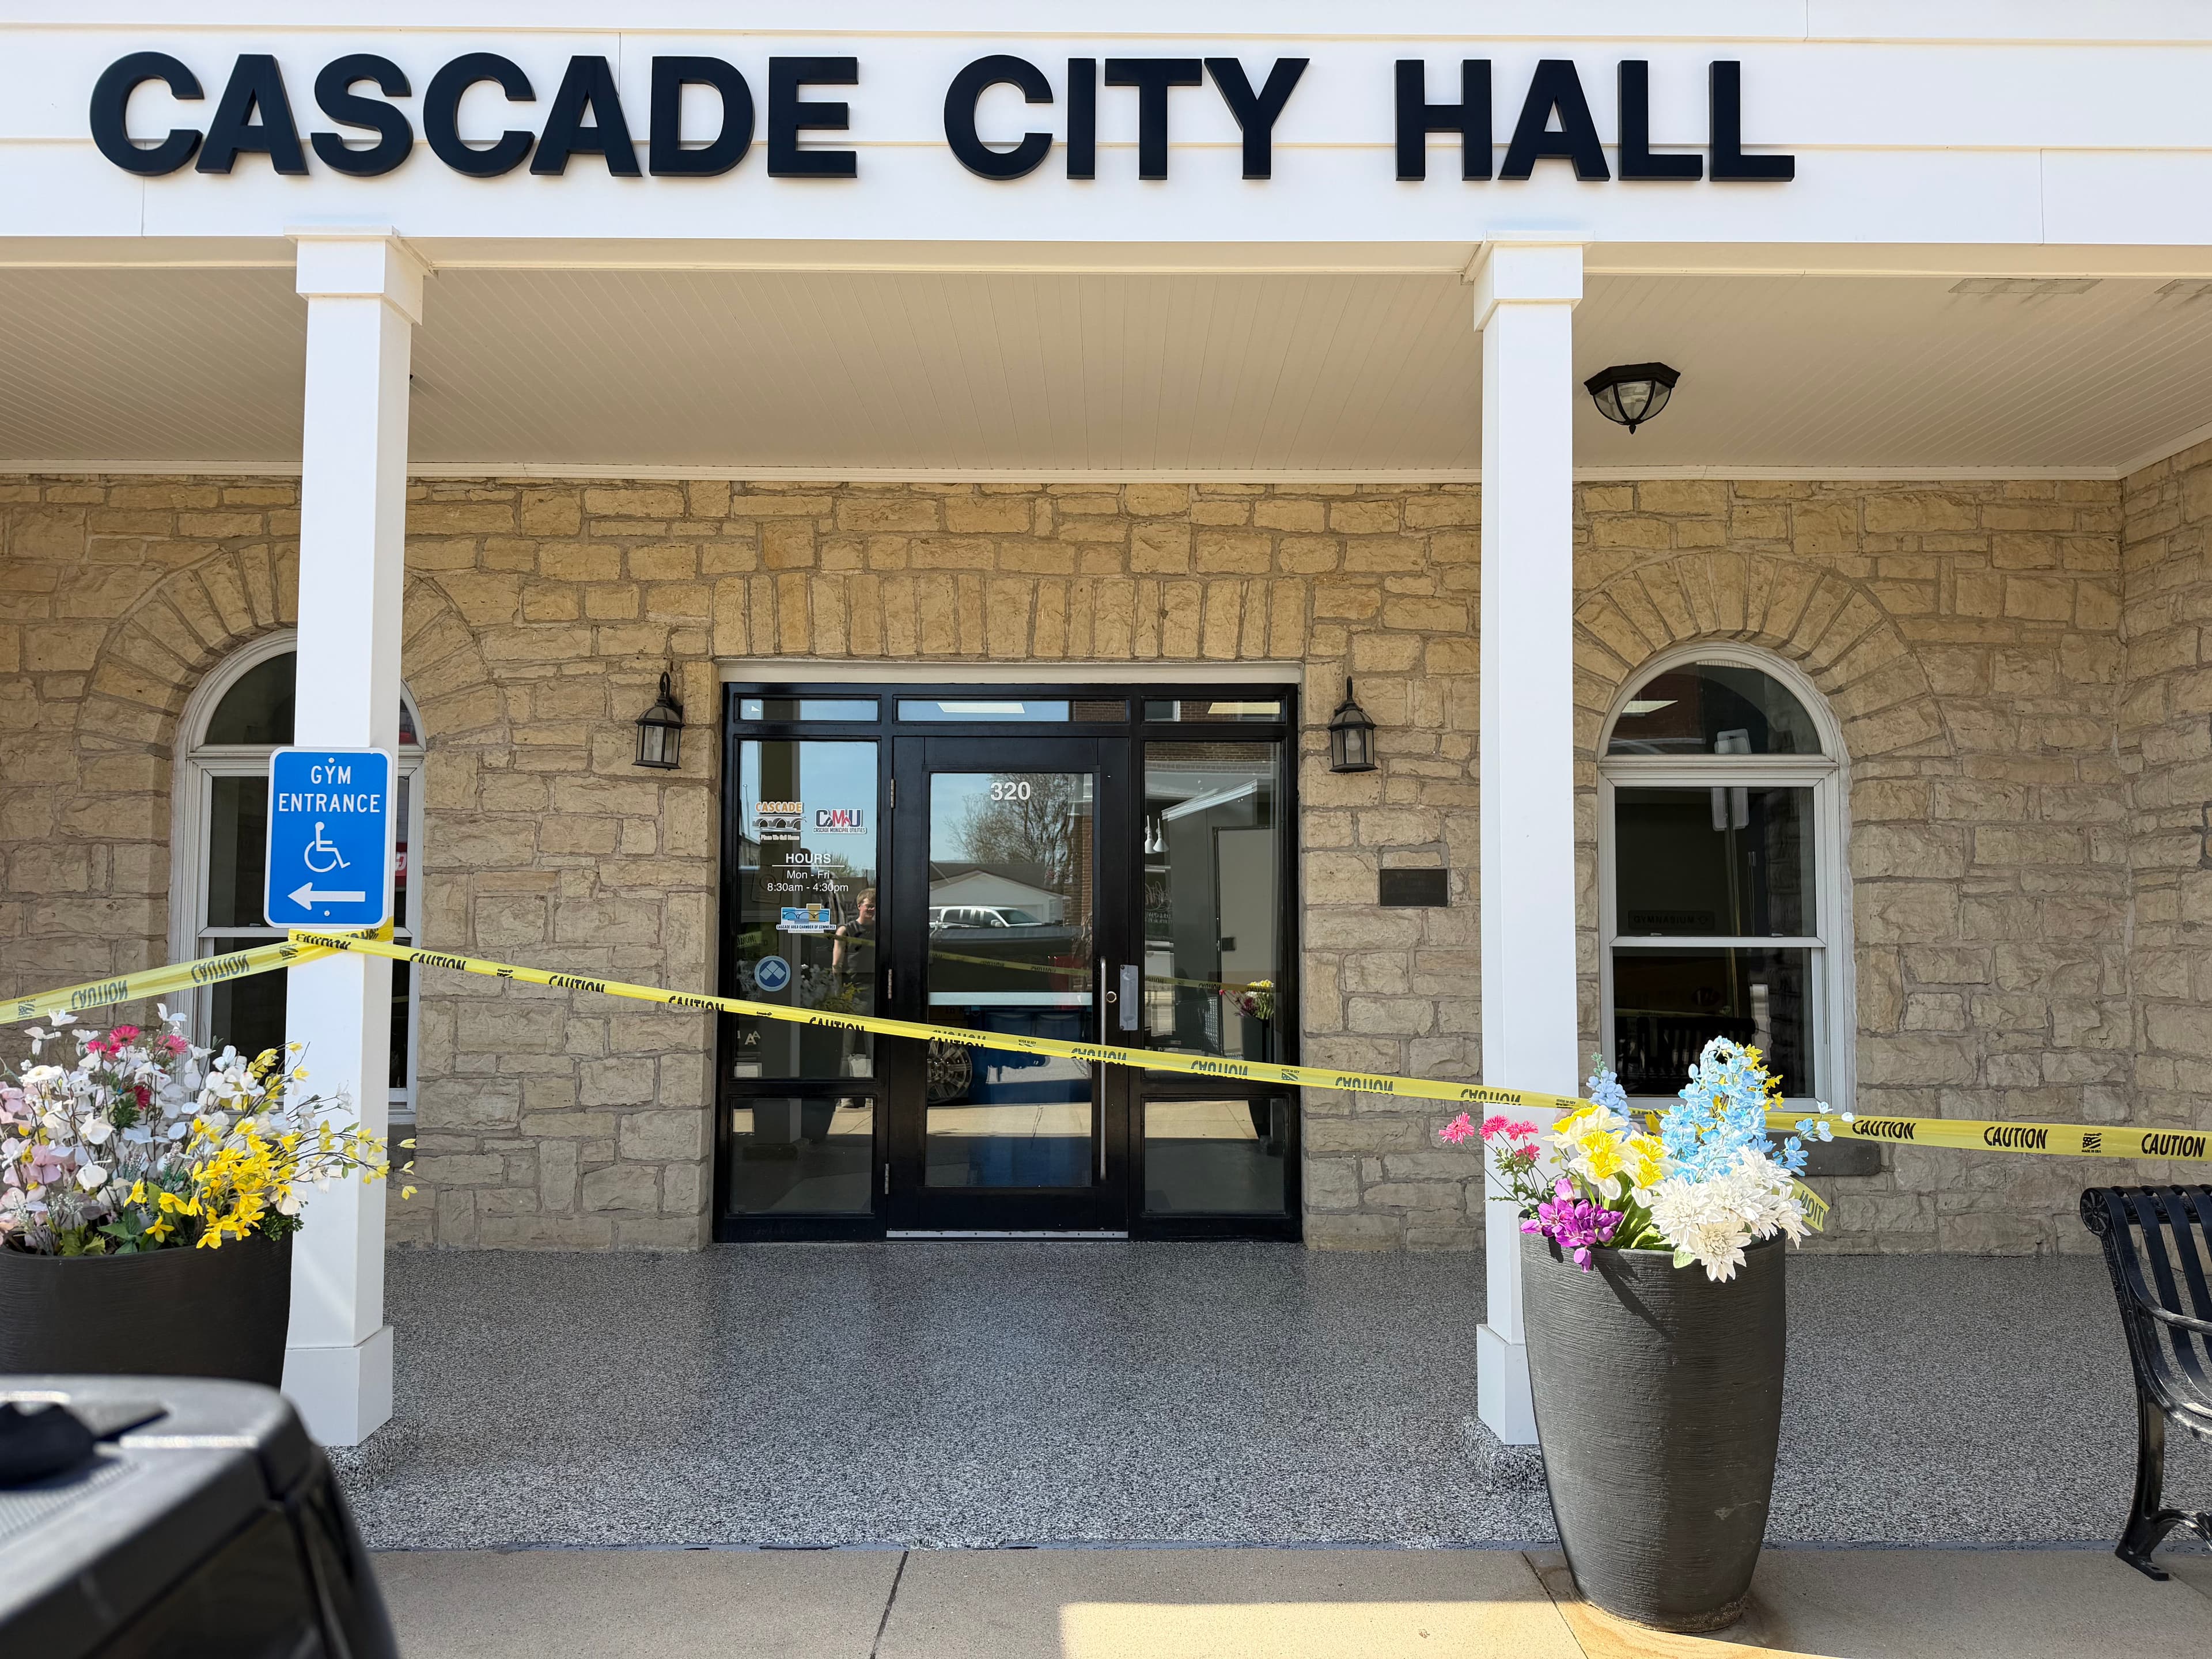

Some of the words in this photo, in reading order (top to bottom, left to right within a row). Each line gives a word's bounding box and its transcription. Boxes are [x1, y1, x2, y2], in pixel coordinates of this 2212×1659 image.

[89, 51, 858, 178] CASCADE
[944, 54, 1310, 181] CITY
[1394, 59, 1796, 182] HALL
[310, 765, 351, 784] GYM
[990, 781, 1031, 801] 320
[279, 793, 380, 813] ENTRANCE
[755, 801, 802, 813] CASCADE
[786, 853, 831, 863] HOURS
[787, 870, 808, 879] Mon
[818, 870, 830, 879] Fri
[767, 882, 803, 892] 8:30am
[813, 882, 849, 893] 4:30pm
[410, 952, 467, 971] CAUTION
[1852, 1119, 1915, 1140] CAUTION
[1983, 1126, 2048, 1149] CAUTION
[2141, 1132, 2206, 1157] CAUTION
